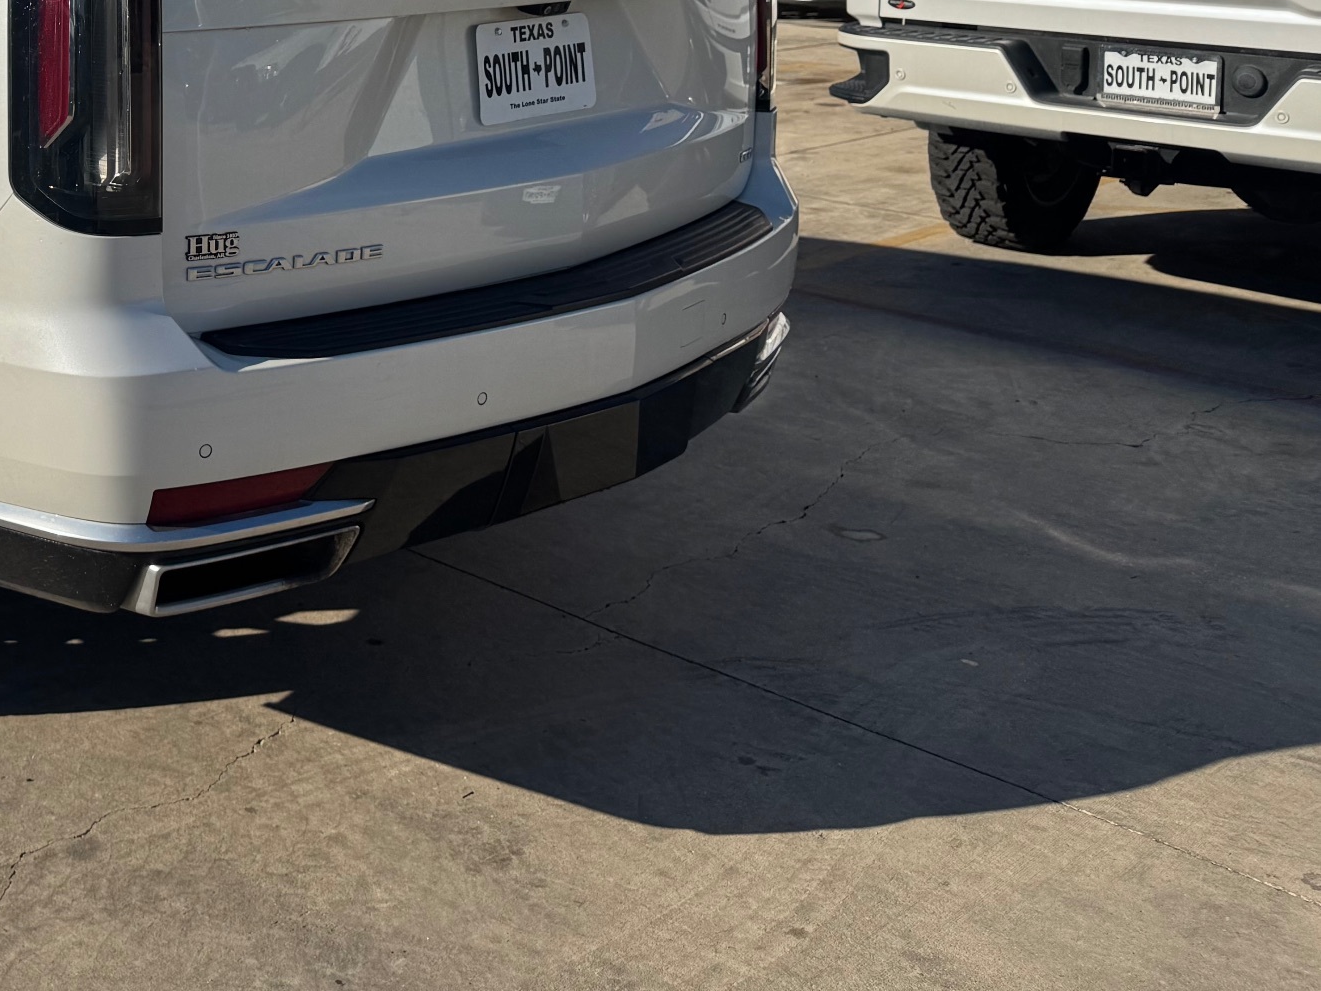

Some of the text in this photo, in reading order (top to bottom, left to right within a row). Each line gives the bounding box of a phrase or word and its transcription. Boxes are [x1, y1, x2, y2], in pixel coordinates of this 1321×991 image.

[510, 22, 554, 43] TEXAS
[483, 42, 586, 98] SOUTH POINT
[1139, 53, 1183, 66] TEXAS
[1105, 63, 1216, 97] SOUTH POINT
[550, 95, 566, 103] State
[188, 235, 239, 257] Hug
[186, 244, 384, 281] ESCALADE
